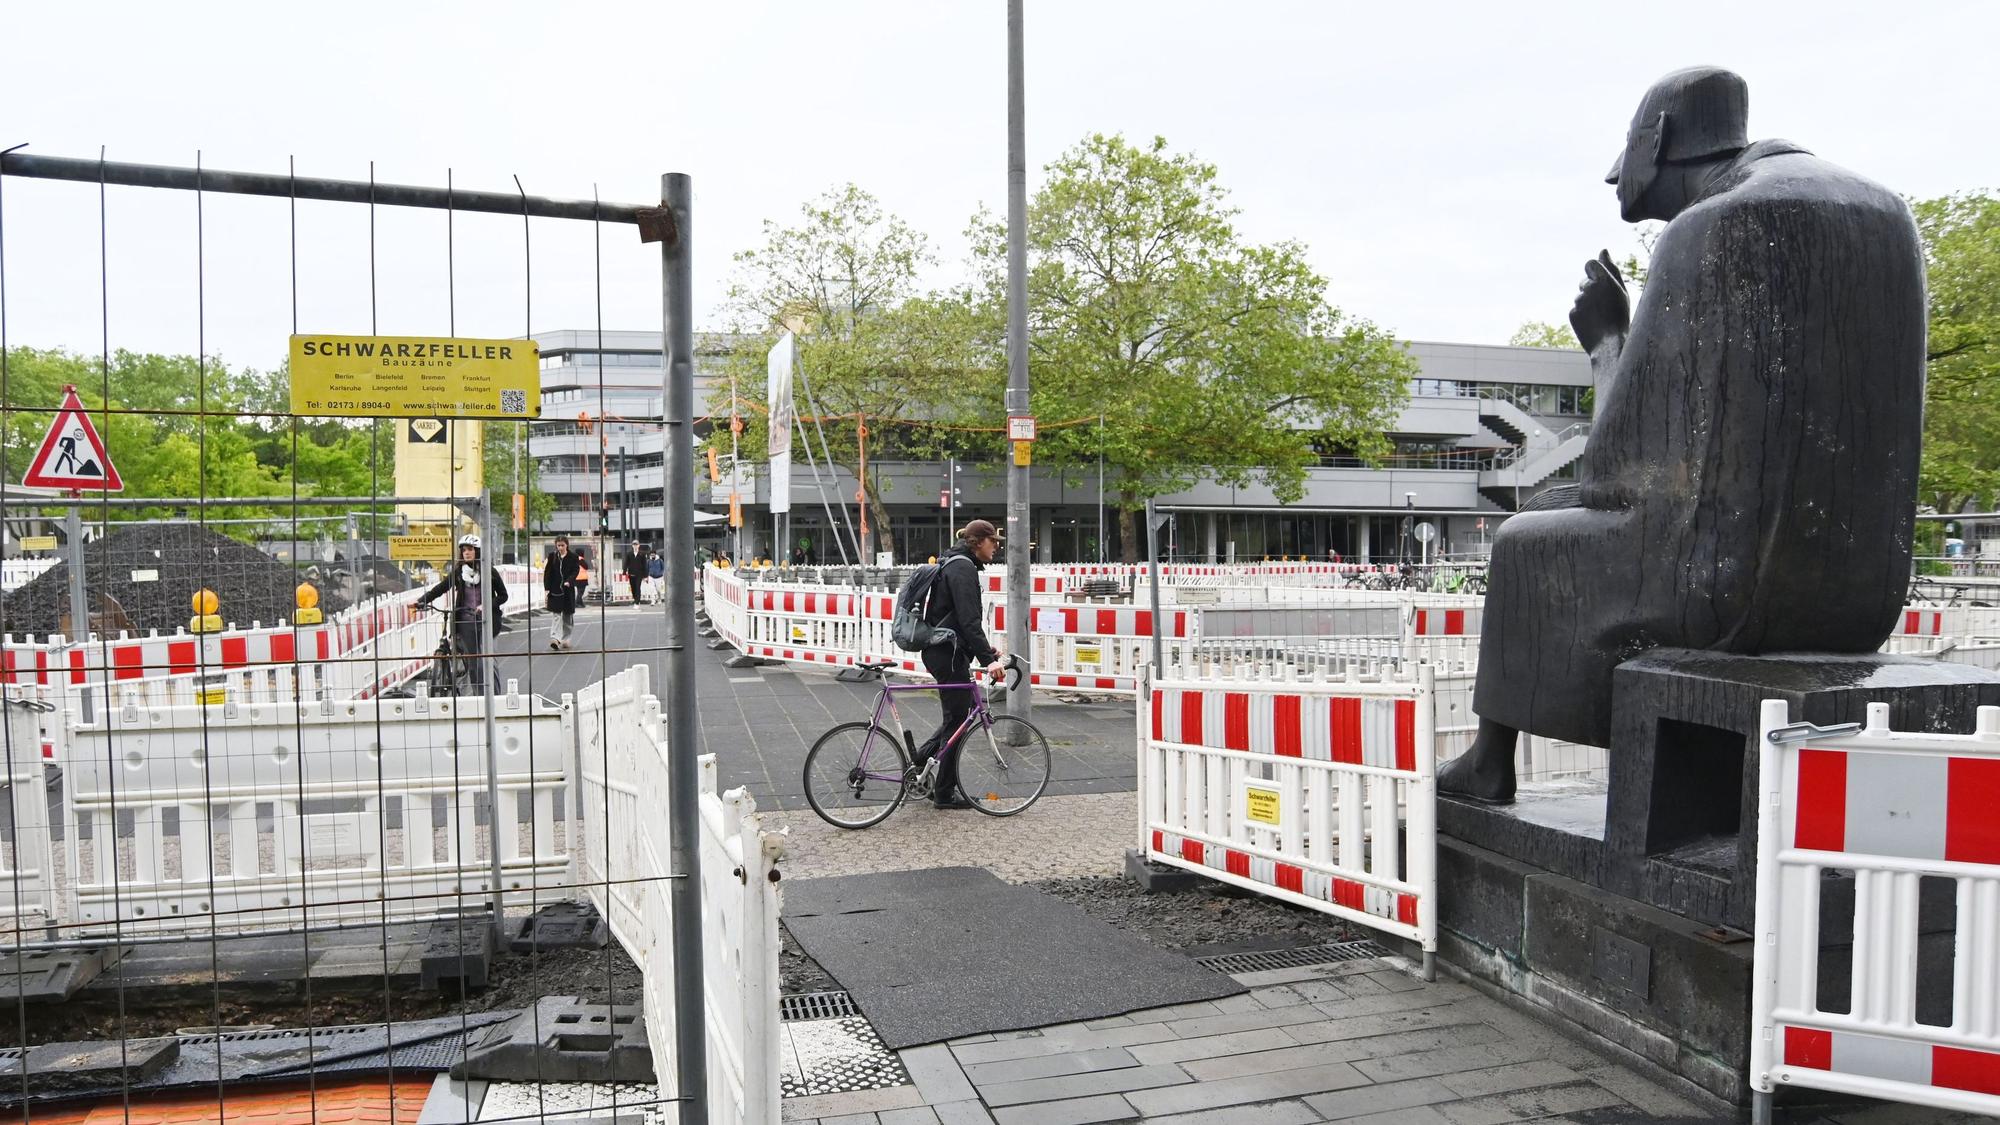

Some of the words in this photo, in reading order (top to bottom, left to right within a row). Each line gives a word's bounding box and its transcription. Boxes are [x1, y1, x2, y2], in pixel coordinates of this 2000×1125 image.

[303, 341, 512, 360] SCHWARZFELLER
[382, 358, 453, 367] Bauzäune
[329, 384, 362, 392] Karlsruhe
[463, 385, 491, 393] Stuttgart
[306, 401, 322, 409] Tel:
[327, 401, 354, 409] 02173
[361, 401, 391, 409] 8904-0
